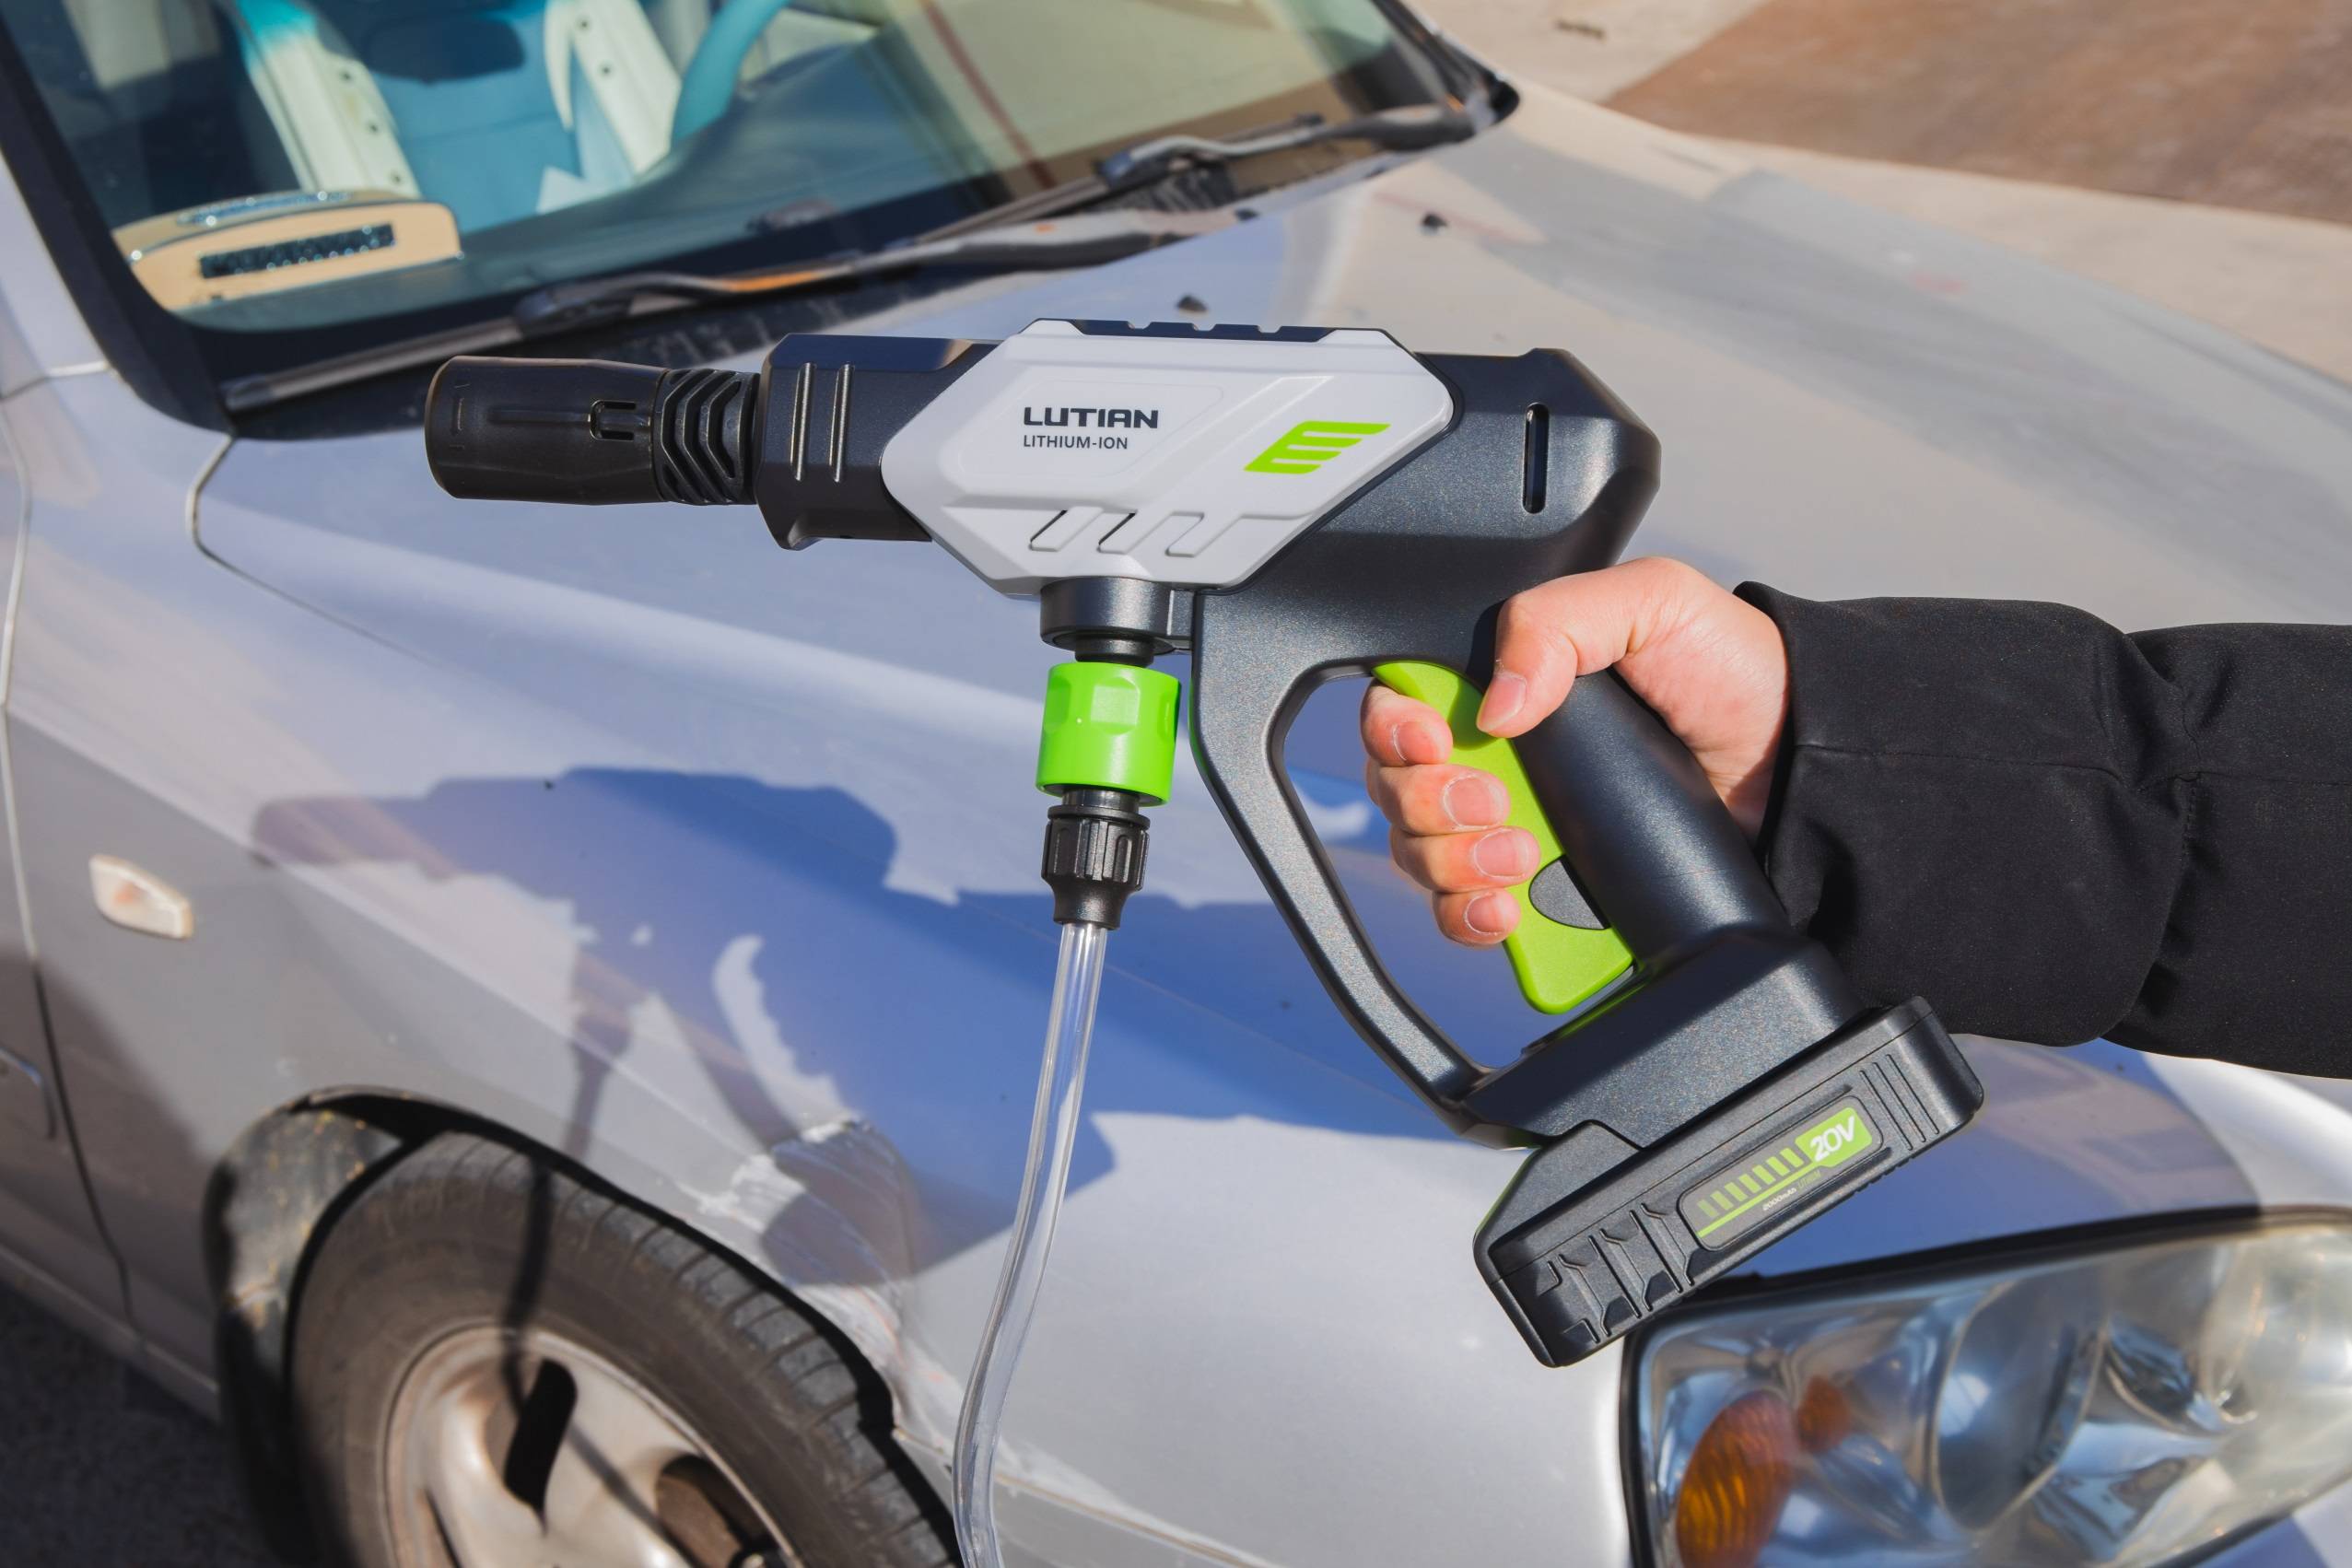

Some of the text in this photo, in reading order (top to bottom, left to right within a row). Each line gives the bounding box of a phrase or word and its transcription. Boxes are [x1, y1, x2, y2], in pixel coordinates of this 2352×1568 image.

[1024, 406, 1159, 429] LUTIAN
[1024, 435, 1128, 450] LITHIUM-ION
[1810, 1115, 1855, 1162] 20V
